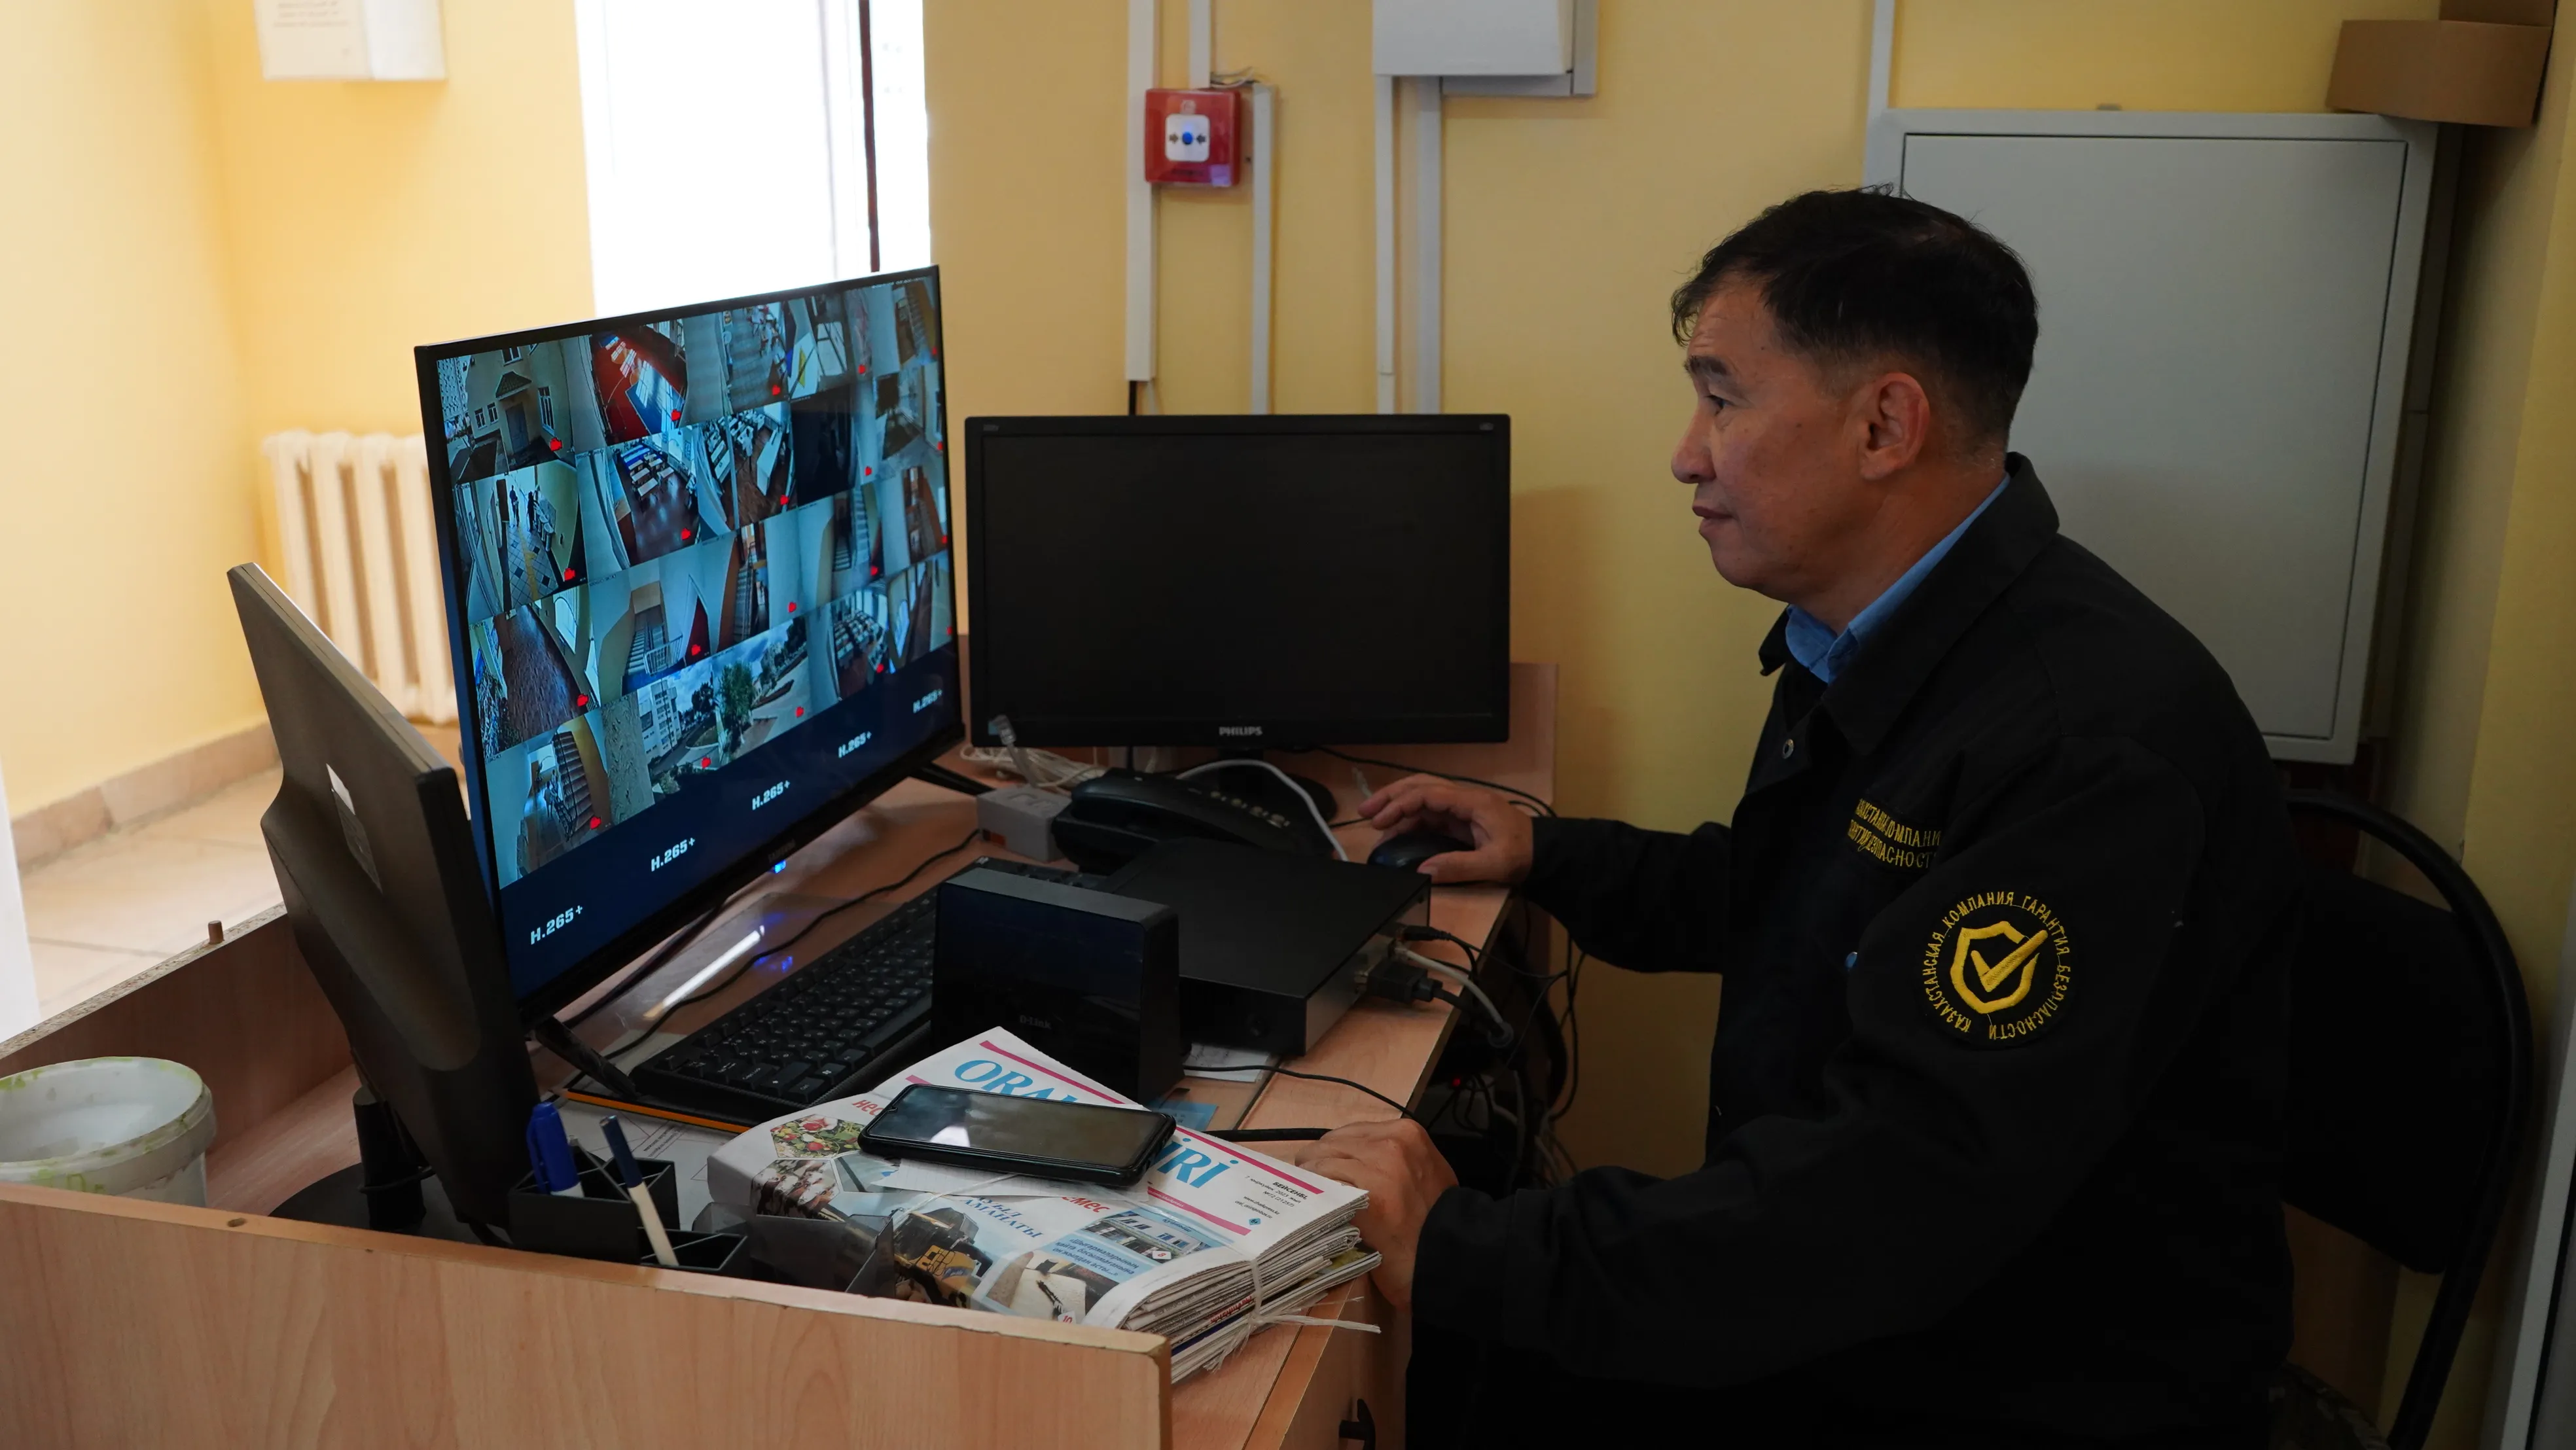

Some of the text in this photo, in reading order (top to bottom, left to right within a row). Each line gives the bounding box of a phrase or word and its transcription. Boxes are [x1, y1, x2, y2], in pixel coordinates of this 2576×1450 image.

[838, 731, 872, 758] H.265+
[1219, 726, 1263, 737] PHILIPS
[752, 781, 791, 810] H.265+
[651, 838, 696, 872] H.265+
[530, 905, 583, 946] H.265+
[1922, 891, 2071, 1040] КАЗАХСТАНСКАЯ КОМПАНИЯ ГАРАНТИЯ БЕЗОПАСНОСТИ
[1020, 1014, 1052, 1031] D-Link
[954, 1059, 1078, 1103] ORA
[1275, 1190, 1289, 1199] 2023
[965, 1199, 1044, 1238] АМАНАТЫ
